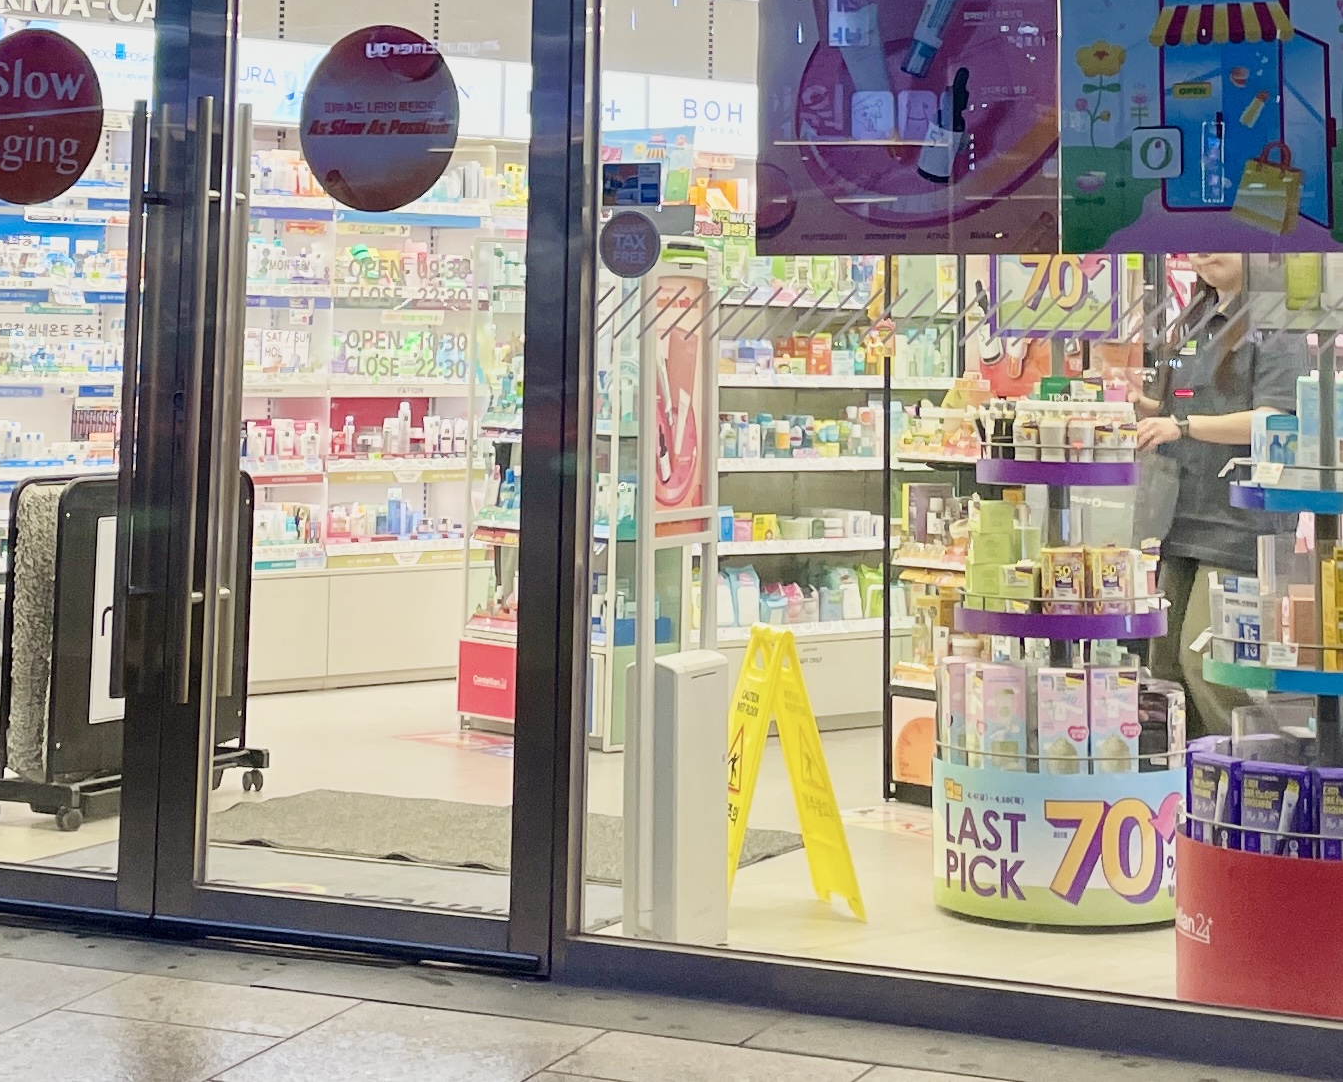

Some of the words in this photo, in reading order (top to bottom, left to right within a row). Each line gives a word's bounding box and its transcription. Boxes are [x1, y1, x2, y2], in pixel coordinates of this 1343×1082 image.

[682, 98, 744, 125] BOH
[327, 118, 368, 135] Slow
[366, 118, 390, 135] As
[613, 233, 646, 250] TAX
[612, 251, 646, 264] FREE
[348, 259, 404, 281] OPEN
[348, 287, 403, 305] CLOSE
[265, 331, 283, 343] SAT
[346, 329, 402, 351] OPEN
[345, 356, 400, 378] CLOSE
[415, 358, 467, 379] 22:30
[741, 689, 760, 704] CAUTION
[945, 802, 1027, 854] LAST
[945, 848, 1027, 901] PICK
